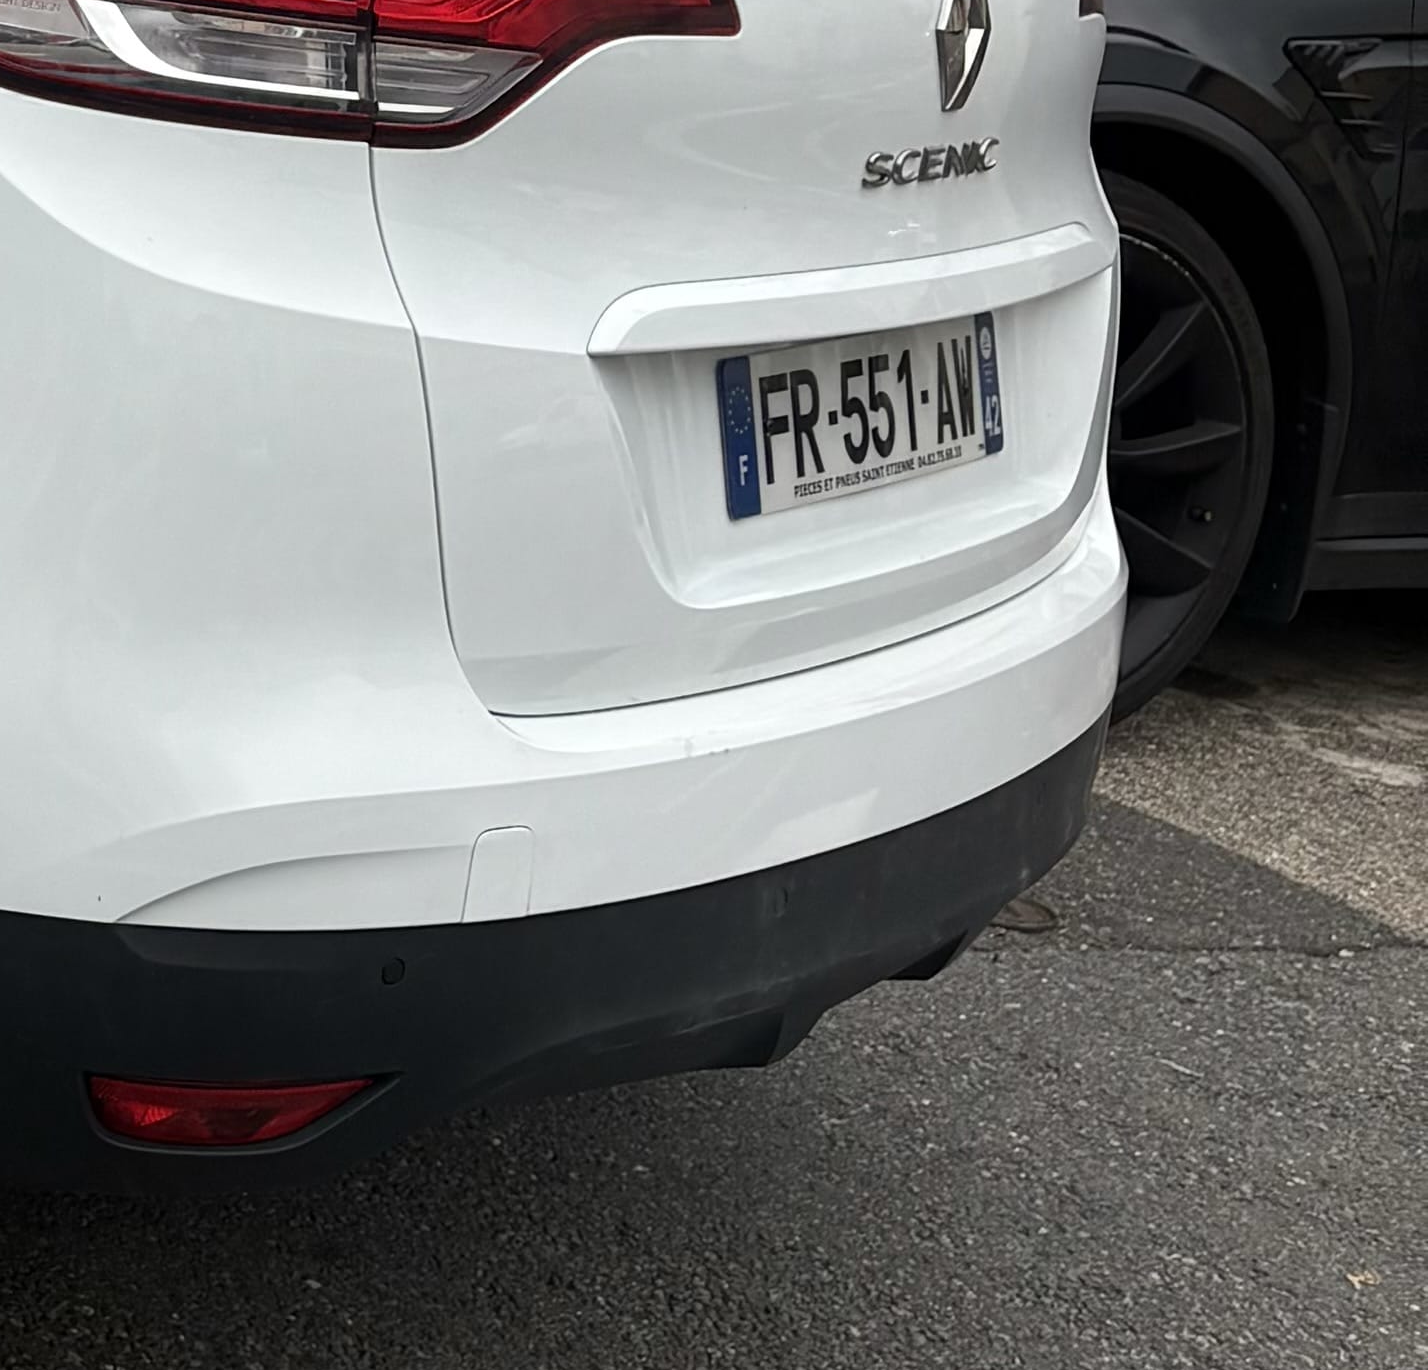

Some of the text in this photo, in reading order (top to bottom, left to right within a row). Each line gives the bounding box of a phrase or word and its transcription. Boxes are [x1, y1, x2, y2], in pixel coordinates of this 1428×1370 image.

[861, 136, 1000, 189] SCENIC
[758, 334, 976, 485] FR-551-AW
[984, 395, 1001, 437] 42
[738, 454, 749, 486] F
[794, 479, 823, 498] PIECES
[823, 477, 834, 492] ET
[835, 471, 862, 490] PNEUS
[862, 465, 885, 483] SAINT
[885, 458, 915, 477] ETIENNE
